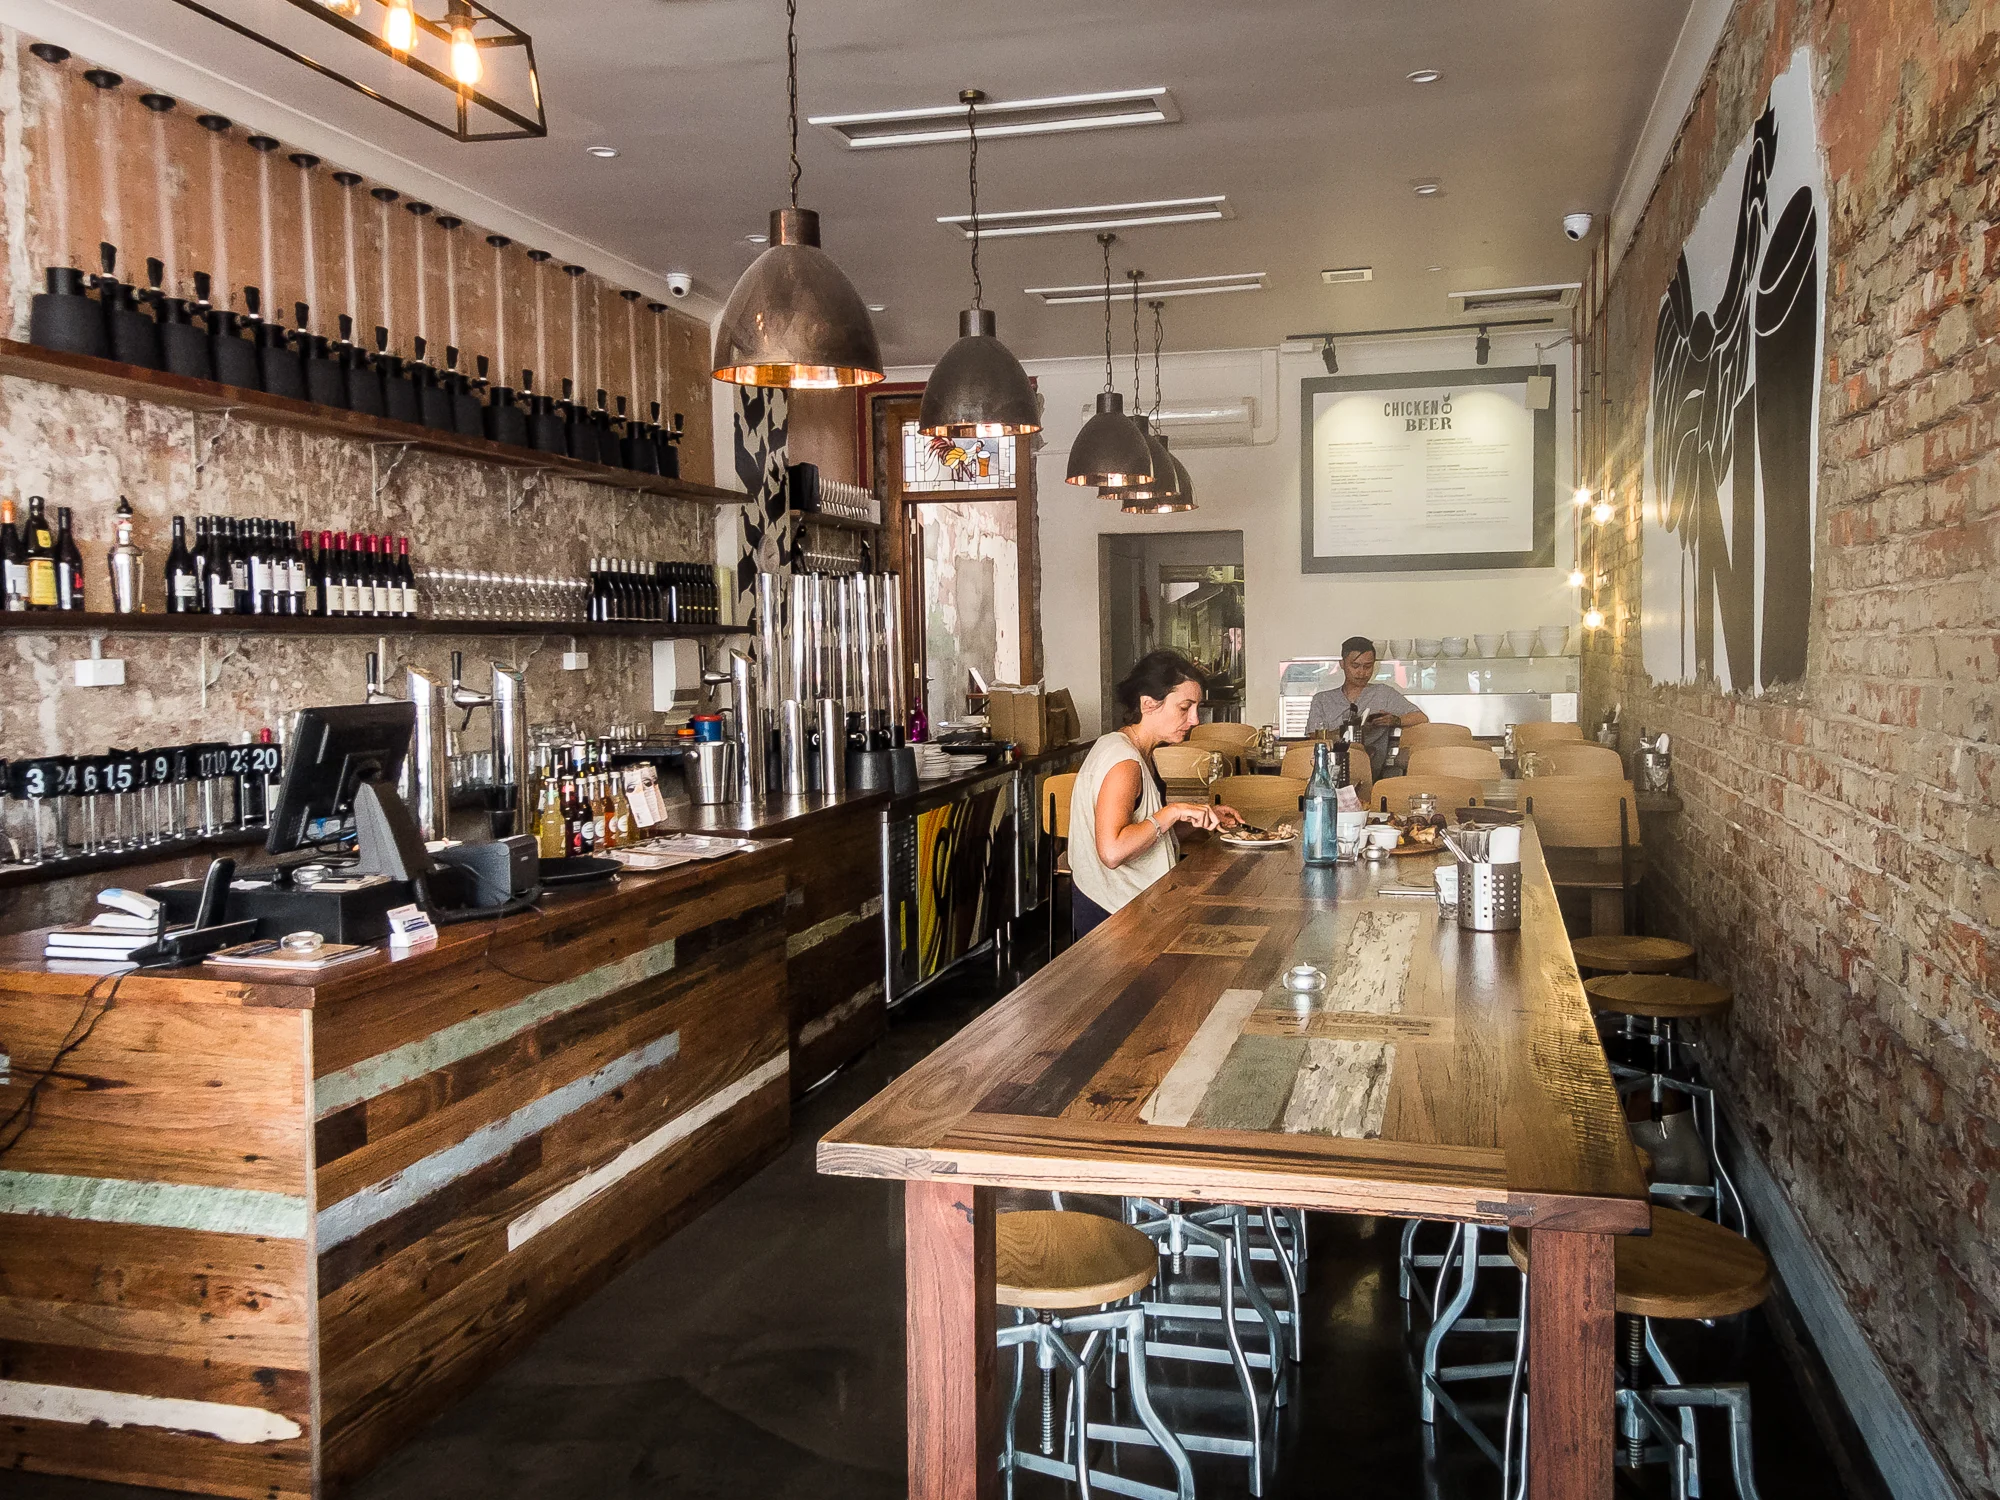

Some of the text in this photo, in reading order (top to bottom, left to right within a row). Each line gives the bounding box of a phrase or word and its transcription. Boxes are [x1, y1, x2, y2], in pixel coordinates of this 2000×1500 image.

[1384, 400, 1439, 417] CHICKEN
[1405, 417, 1452, 432] BEER
[155, 756, 168, 780] 9
[252, 748, 278, 771] 20
[26, 768, 45, 794] 3
[84, 765, 98, 791] 6
[103, 764, 133, 789] 15
